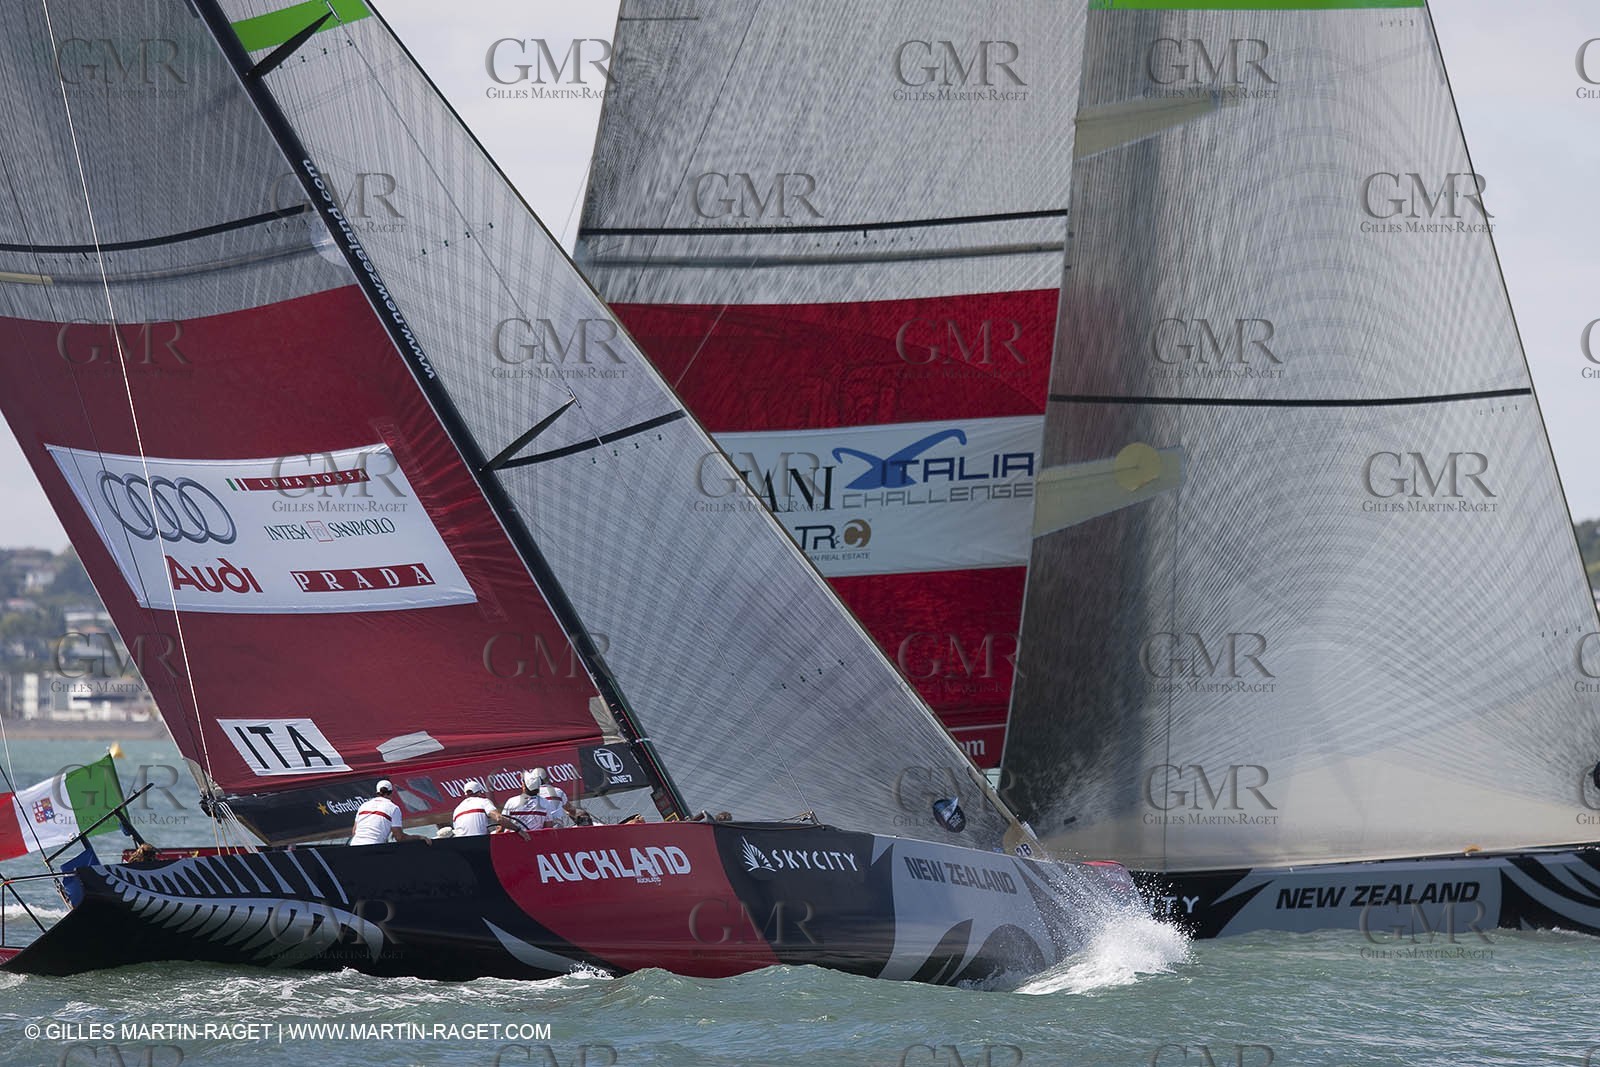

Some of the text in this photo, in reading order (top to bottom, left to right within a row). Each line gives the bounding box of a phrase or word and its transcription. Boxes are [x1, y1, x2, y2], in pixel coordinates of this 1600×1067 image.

[303, 159, 436, 379] www.newzealand.com
[259, 477, 304, 488] LUNA
[882, 452, 1034, 487] ITALIA
[842, 482, 1034, 509] CHALLENGE
[264, 517, 396, 541] INTESA SANPAOLO
[821, 553, 840, 561] REAL
[842, 552, 871, 560] ESTATE
[293, 565, 432, 591] PRADA
[234, 725, 333, 770] ITA
[536, 846, 692, 884] AUCKLAND
[769, 849, 858, 872] SKYCITY
[904, 856, 1018, 895] NEW ZEALAND
[1276, 881, 1480, 910] NEW ZEALAND
